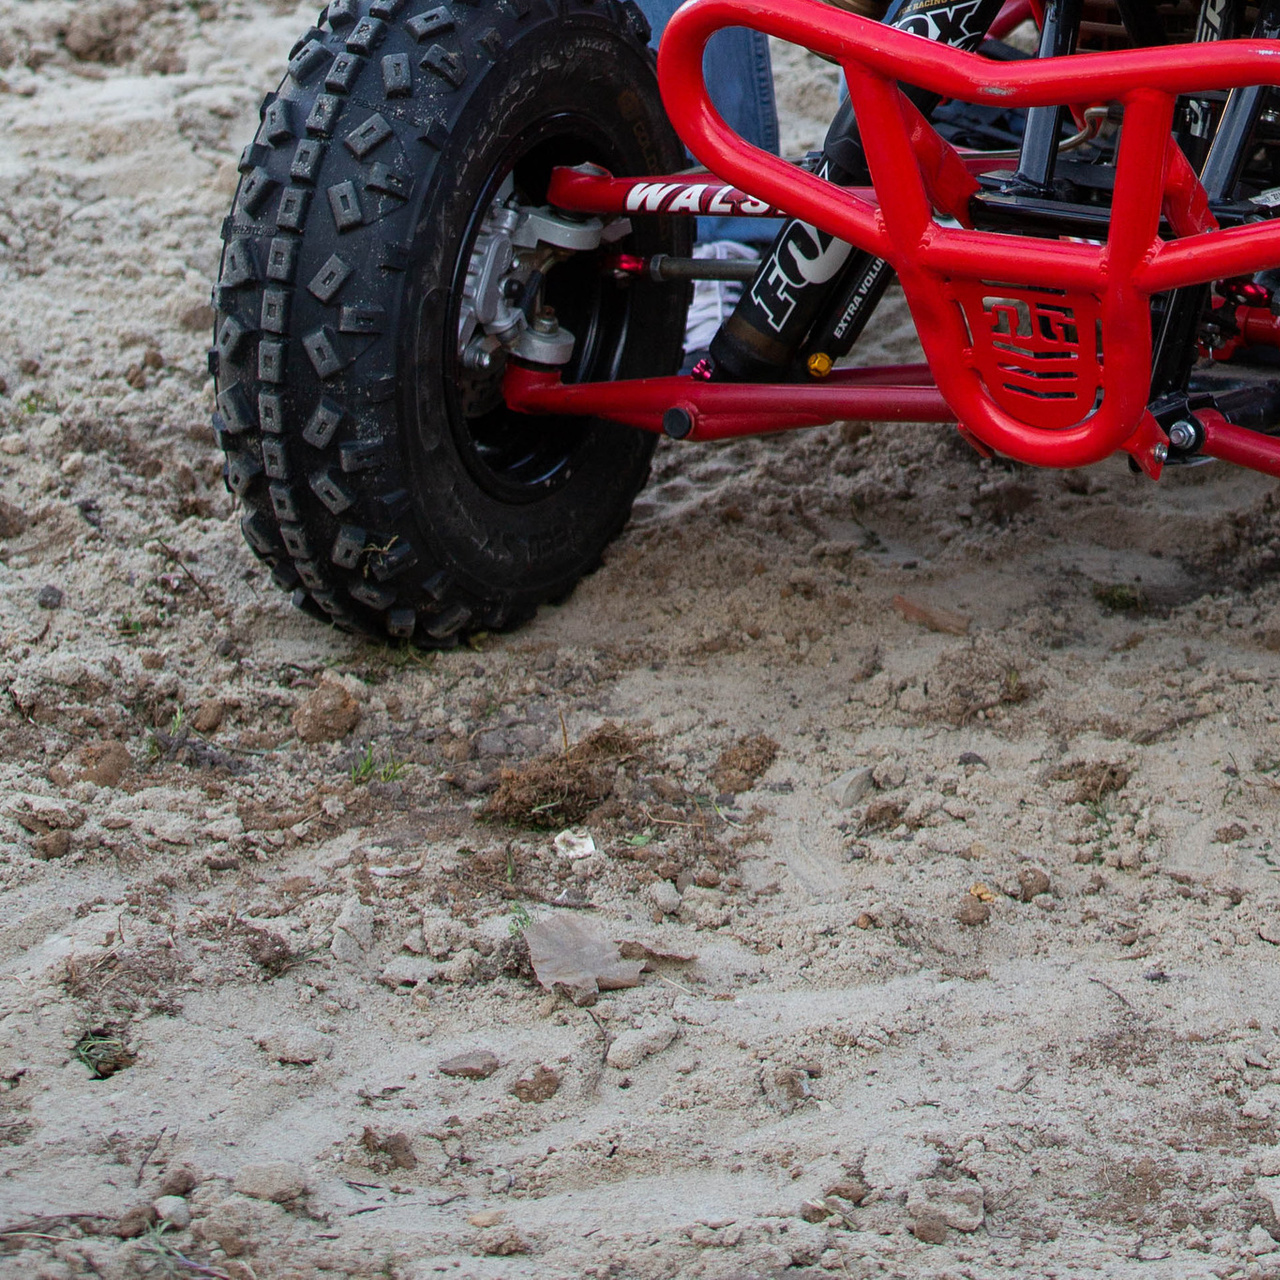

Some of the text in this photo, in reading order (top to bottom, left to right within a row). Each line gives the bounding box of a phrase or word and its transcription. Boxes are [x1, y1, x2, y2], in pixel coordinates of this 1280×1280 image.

[626, 182, 787, 215] WALS
[833, 257, 885, 339] EXTRA VOLU
